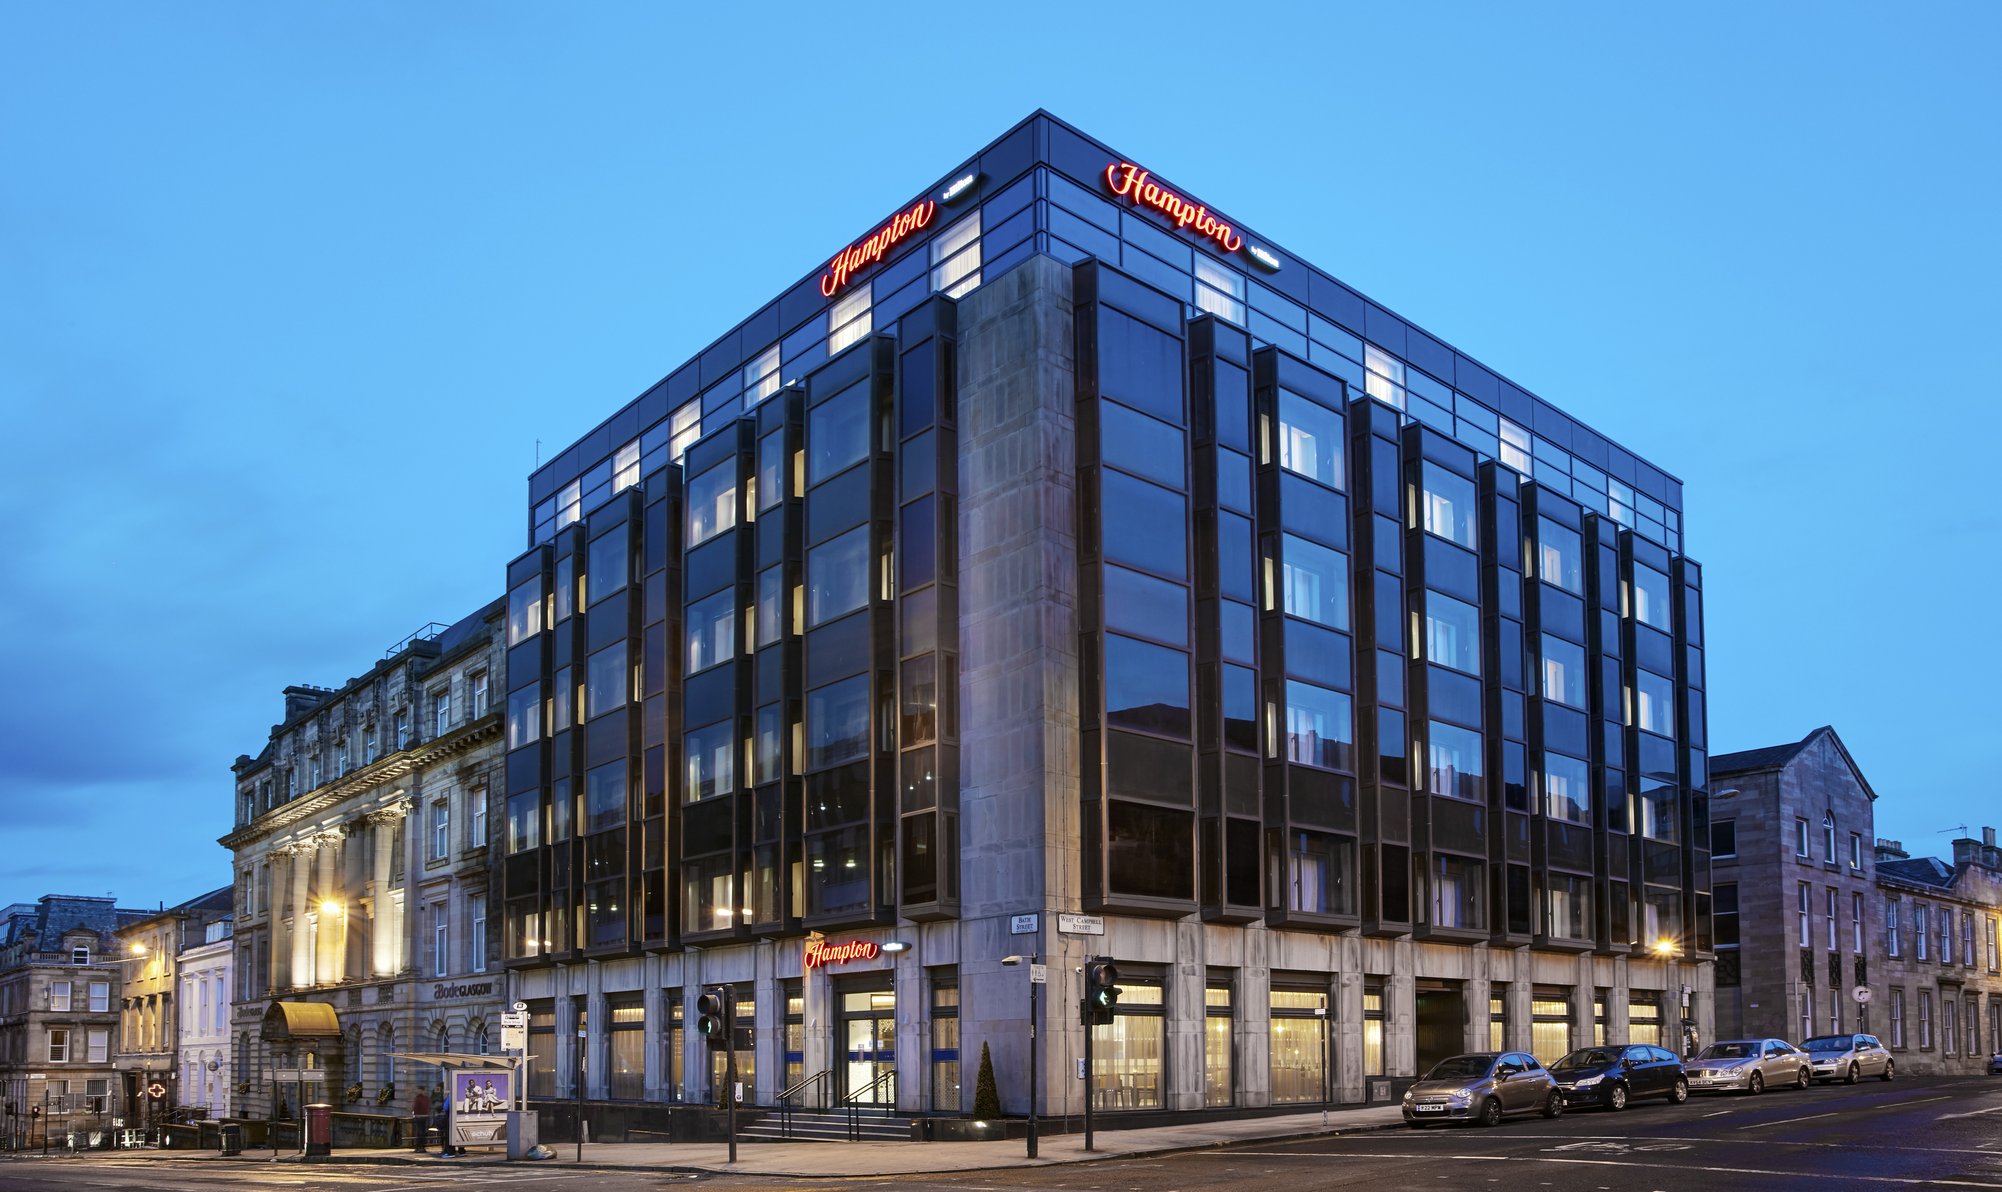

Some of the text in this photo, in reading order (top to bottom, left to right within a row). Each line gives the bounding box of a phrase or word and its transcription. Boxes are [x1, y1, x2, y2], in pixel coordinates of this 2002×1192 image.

[1106, 162, 1242, 252] Hampton
[821, 199, 935, 297] Hampton
[1060, 915, 1102, 925] WEST CAMPBELL
[804, 940, 878, 968] Hampton
